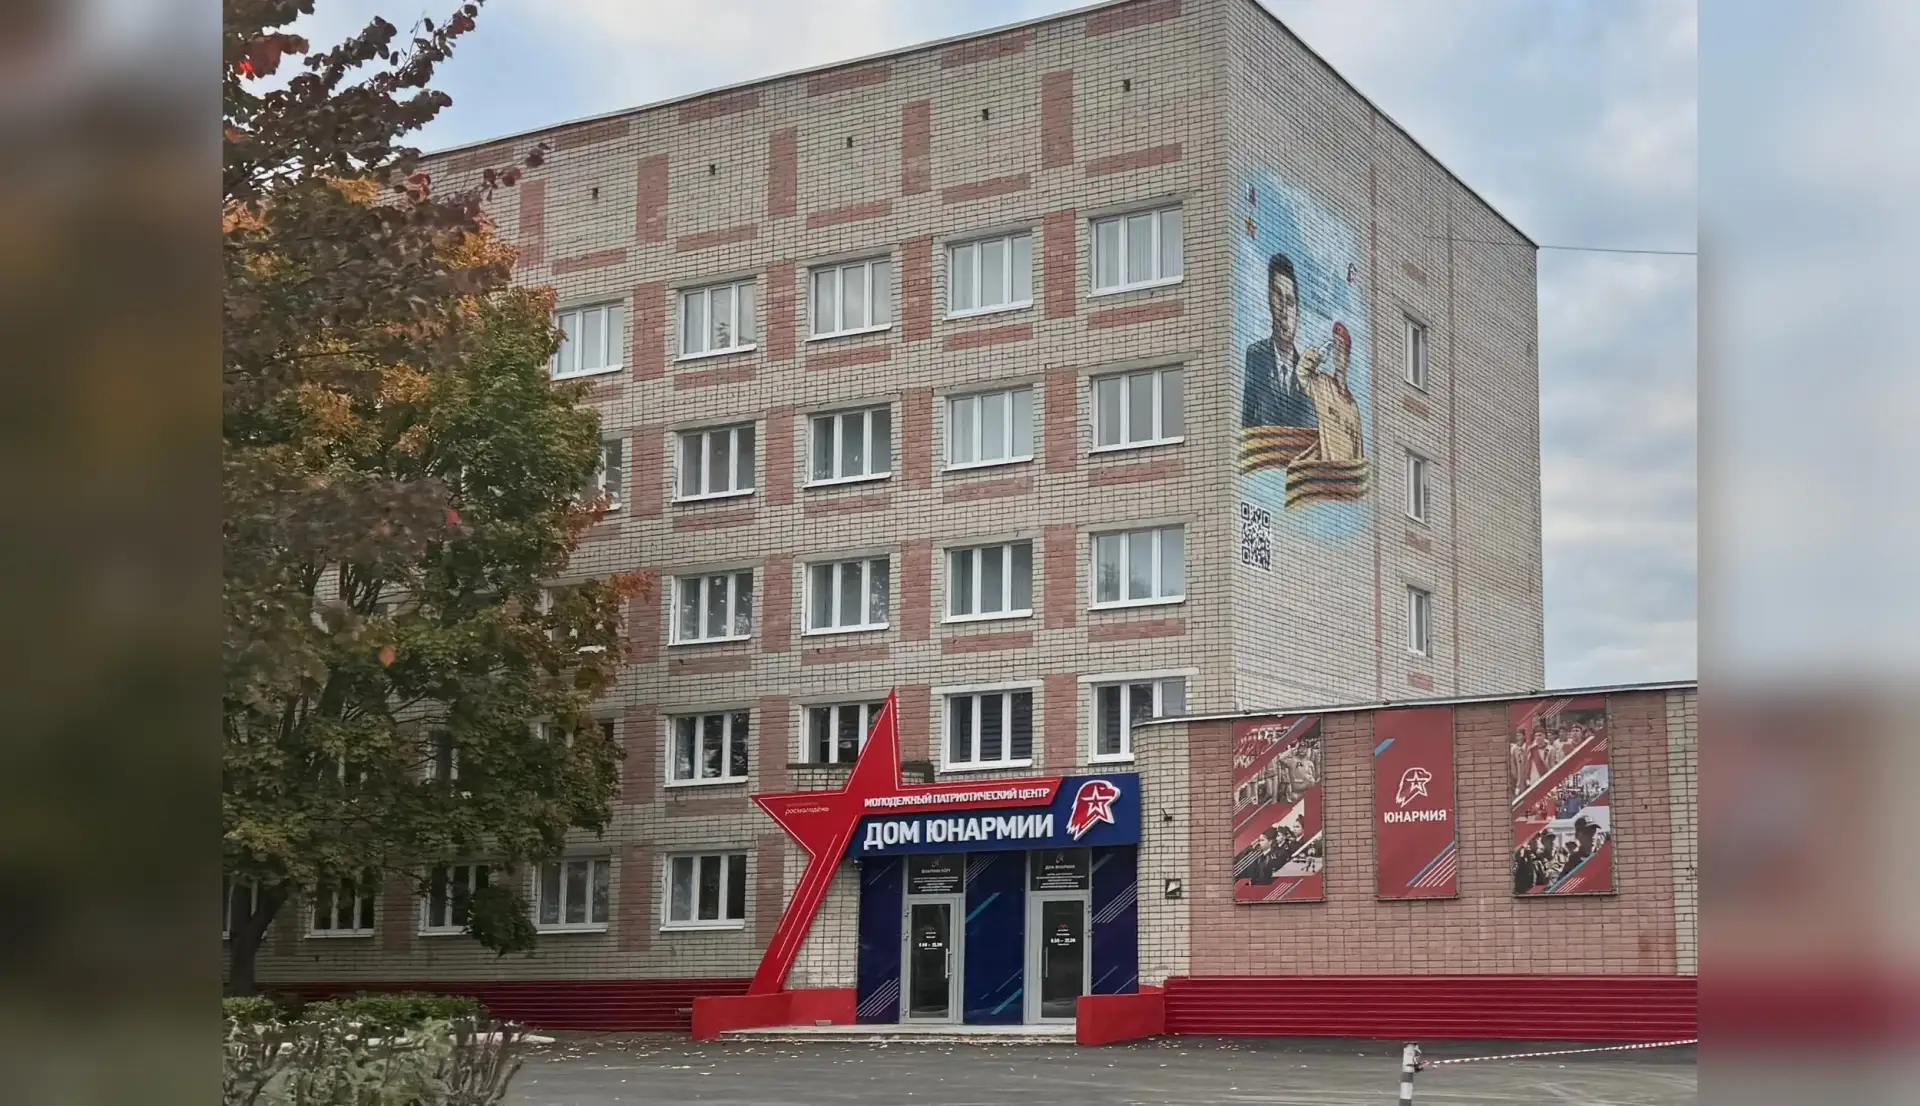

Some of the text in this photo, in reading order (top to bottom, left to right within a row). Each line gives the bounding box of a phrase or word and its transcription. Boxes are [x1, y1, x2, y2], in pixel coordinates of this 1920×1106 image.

[864, 787, 1050, 808] МОЛОДЕЖНЫЙ ПАТРИОТИЧЕСКИЙ ЦЕНТР
[1384, 809, 1447, 823] ЮНАРМИЯ
[863, 814, 1054, 850] ДОМ ЮНАРМИИ
